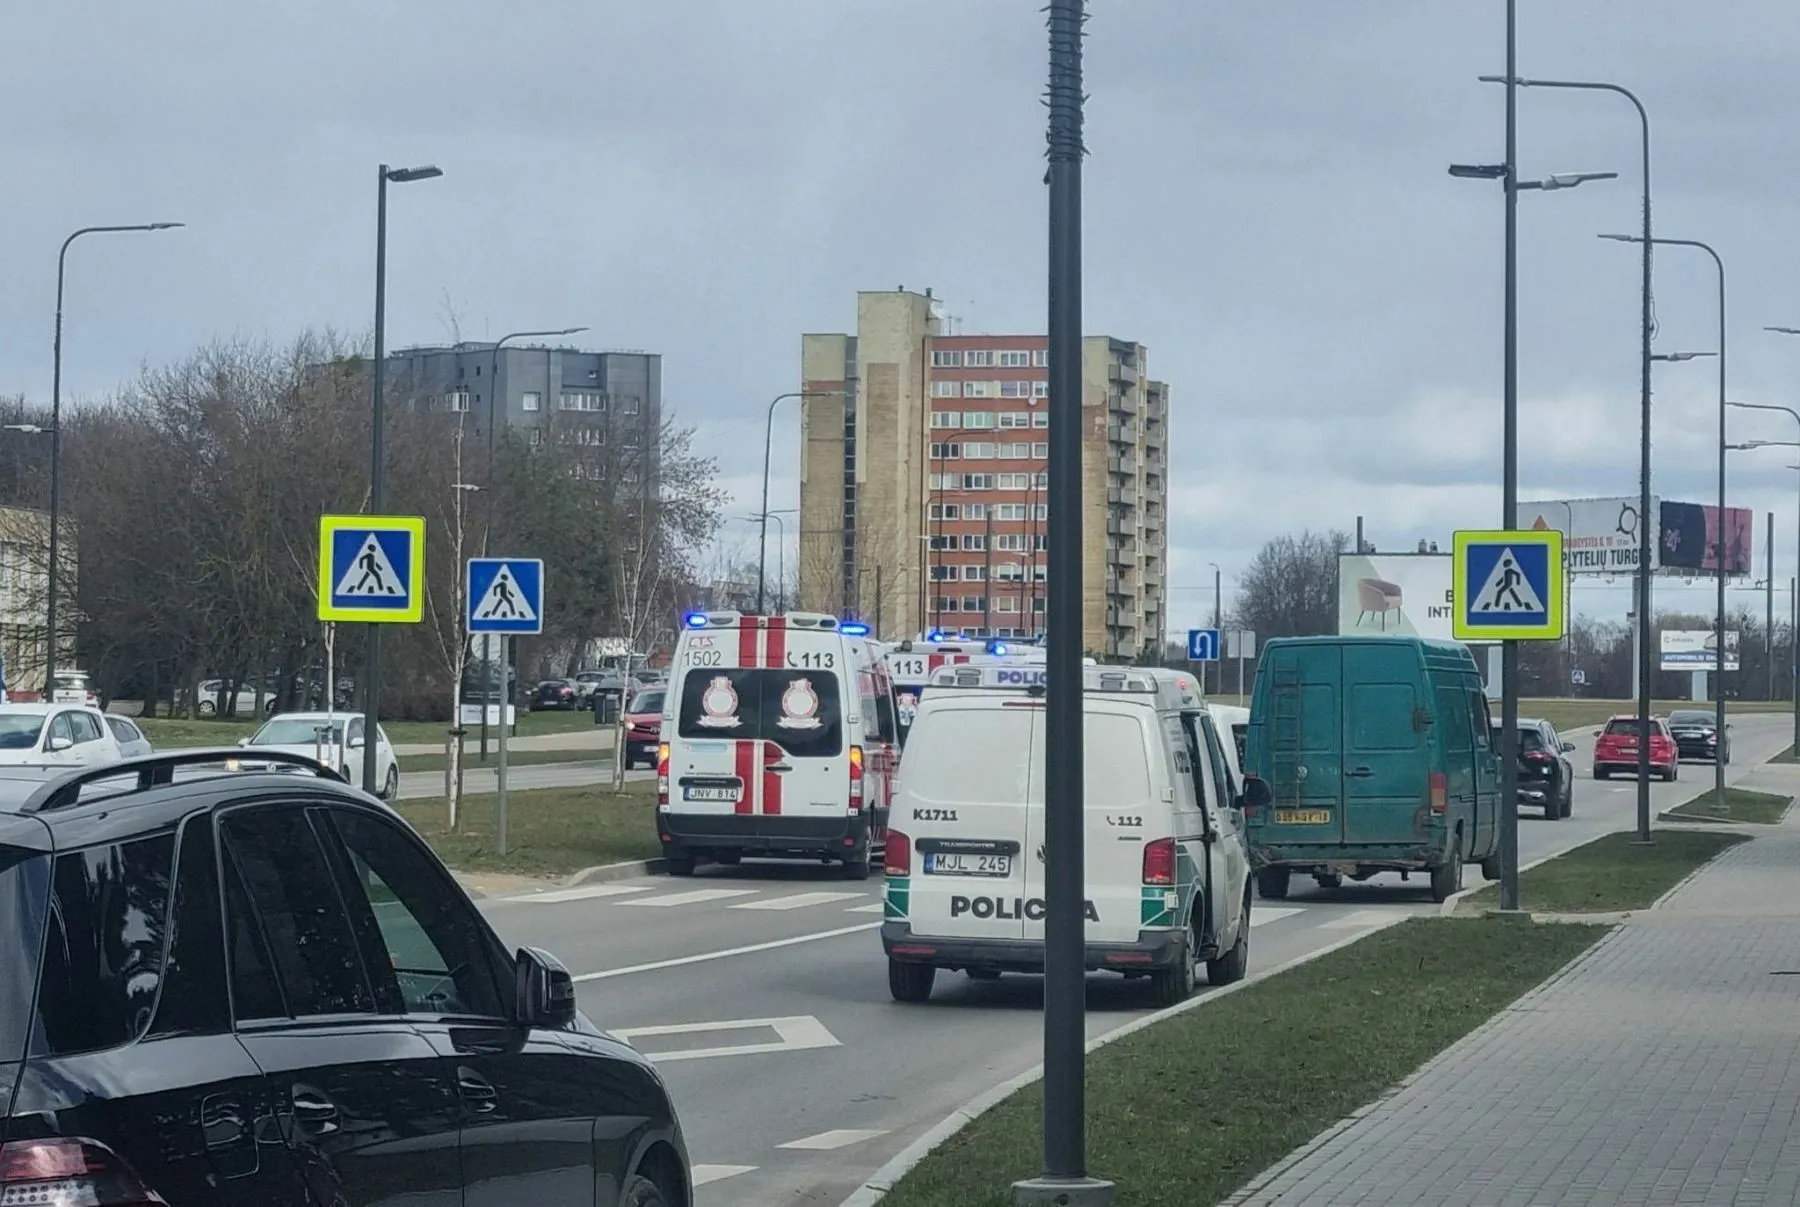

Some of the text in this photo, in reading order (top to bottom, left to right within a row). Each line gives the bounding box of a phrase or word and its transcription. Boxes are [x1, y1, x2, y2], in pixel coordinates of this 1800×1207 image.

[685, 651, 721, 666] 1502
[802, 653, 834, 668] 113
[894, 660, 923, 675] 113
[690, 789, 736, 799] JNV 814
[913, 808, 958, 821] K1711
[1118, 815, 1142, 827] 112
[936, 855, 1007, 871] MJL 245
[951, 895, 1101, 923] POLICA
